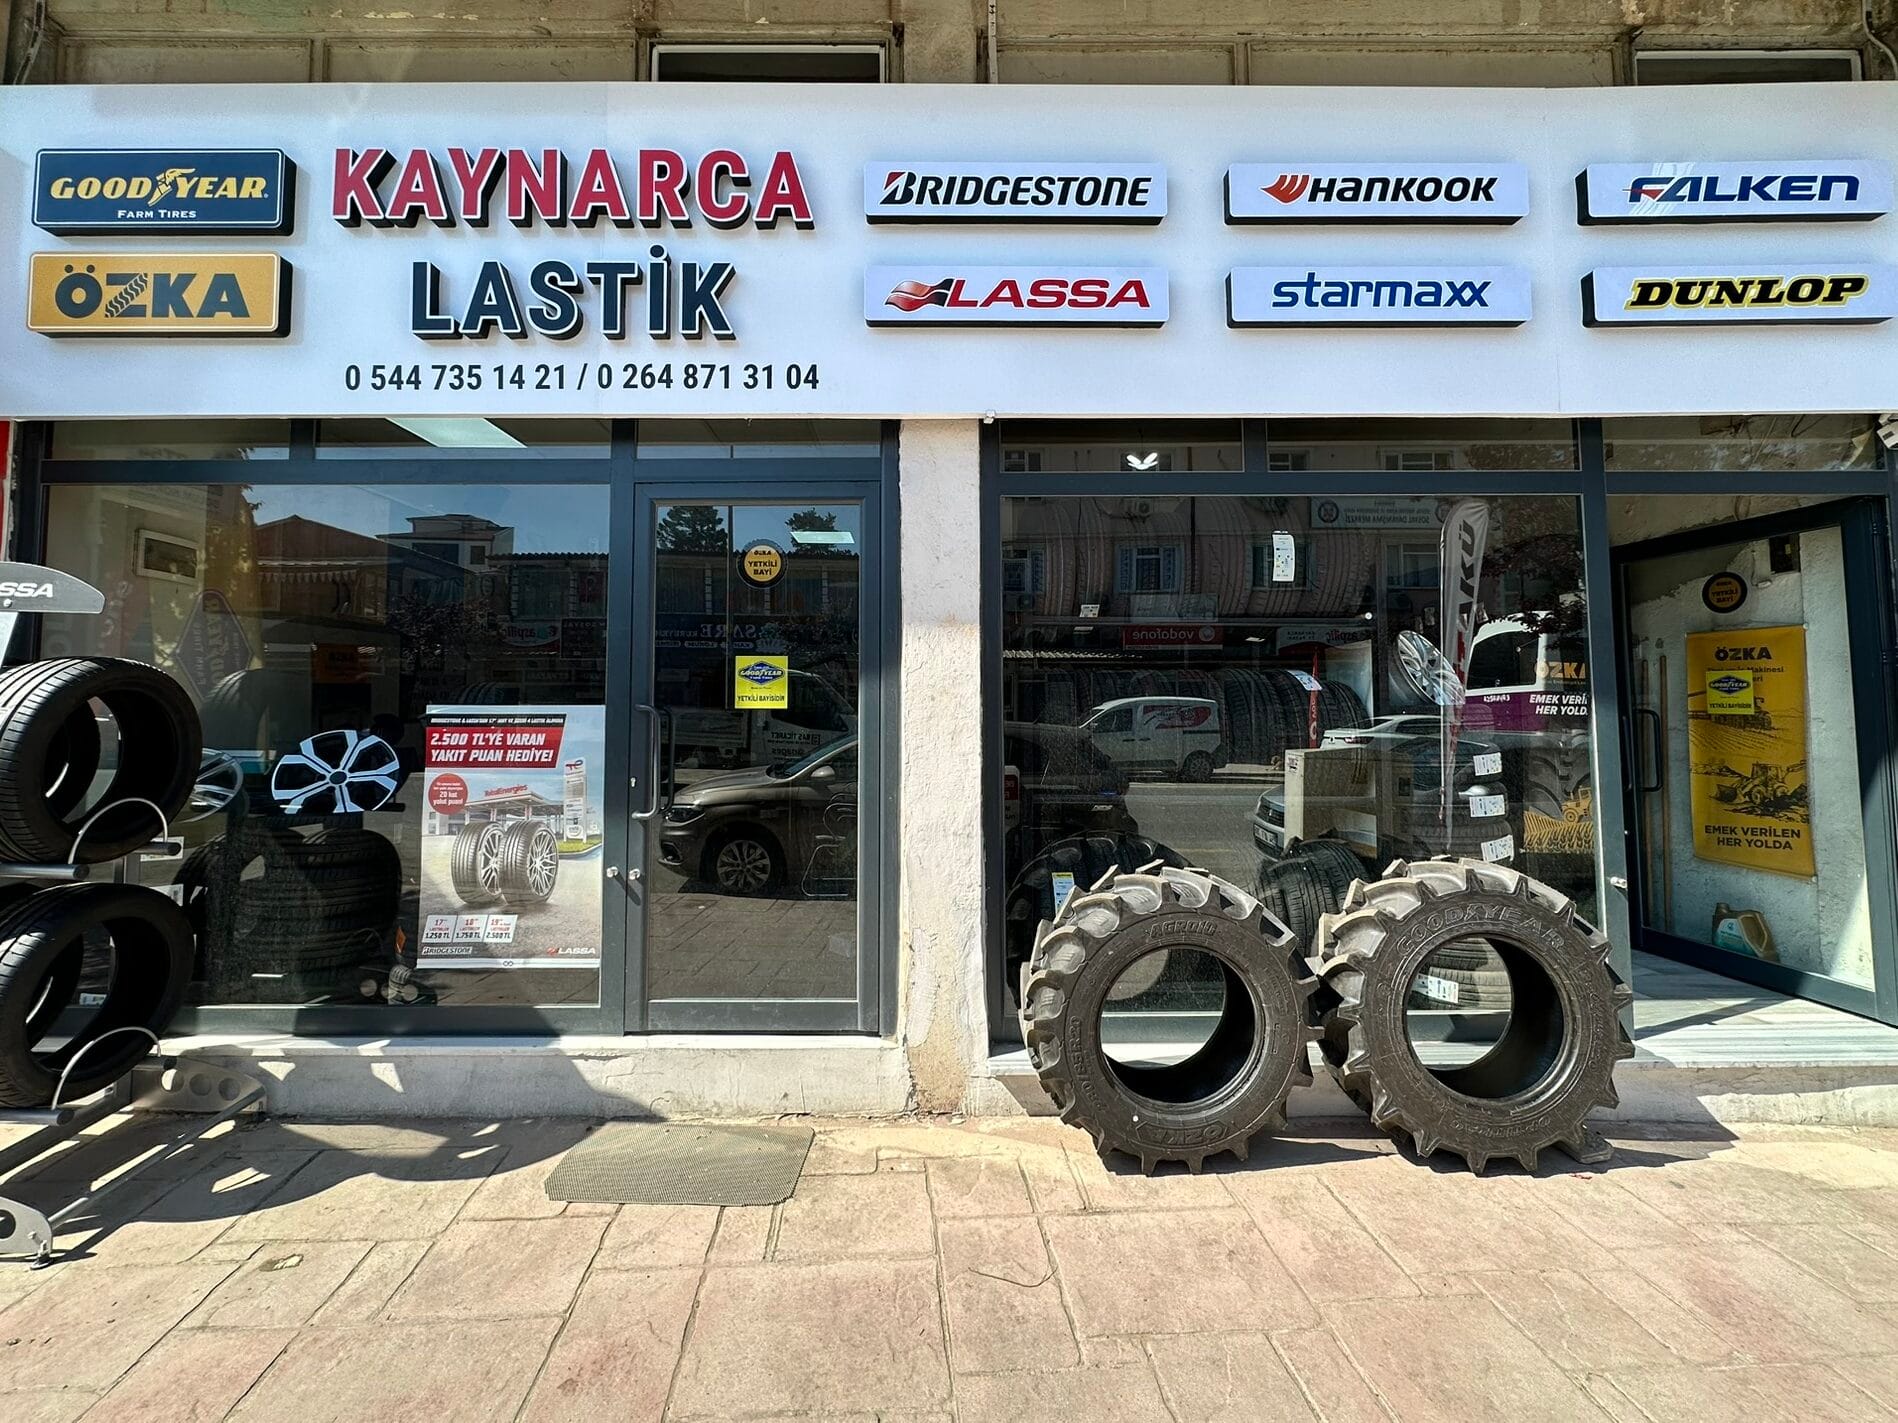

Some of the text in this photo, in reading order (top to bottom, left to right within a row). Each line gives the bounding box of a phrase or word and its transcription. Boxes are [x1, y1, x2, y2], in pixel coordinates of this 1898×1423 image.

[333, 148, 815, 226] KAYNARCA
[880, 171, 1152, 206] BRIDGESTONE
[1628, 174, 1861, 203] FALKEN
[117, 210, 197, 218] FARM TIRES
[55, 264, 250, 318] ÖZKA
[410, 244, 736, 338] LASTİK
[944, 278, 1151, 309] LASSA
[1271, 271, 1492, 308] starmaxx
[1626, 276, 1868, 310] DUNLOP
[345, 365, 360, 390] 0
[370, 364, 421, 390] 544
[431, 364, 482, 390] 735
[493, 364, 526, 390] 14
[534, 364, 566, 390] 21
[597, 364, 612, 389] 0
[622, 363, 674, 389] 264
[683, 363, 731, 389] 871
[743, 364, 774, 389] 31
[786, 363, 820, 389] 04
[1714, 645, 1773, 661] ÖZKA
[1529, 693, 1588, 705] EMEK VERİ
[1535, 705, 1588, 716] HER YOLD
[430, 733, 546, 746] 2.500 TL'YE VARAN
[431, 747, 555, 762] YAKIT PUAN HEDİYE!
[1704, 825, 1801, 839] EMEK VERİLEN
[1717, 837, 1793, 850] HER YOLDA
[1396, 902, 1565, 957] GOODYEAR
[555, 947, 596, 955] LASSA
